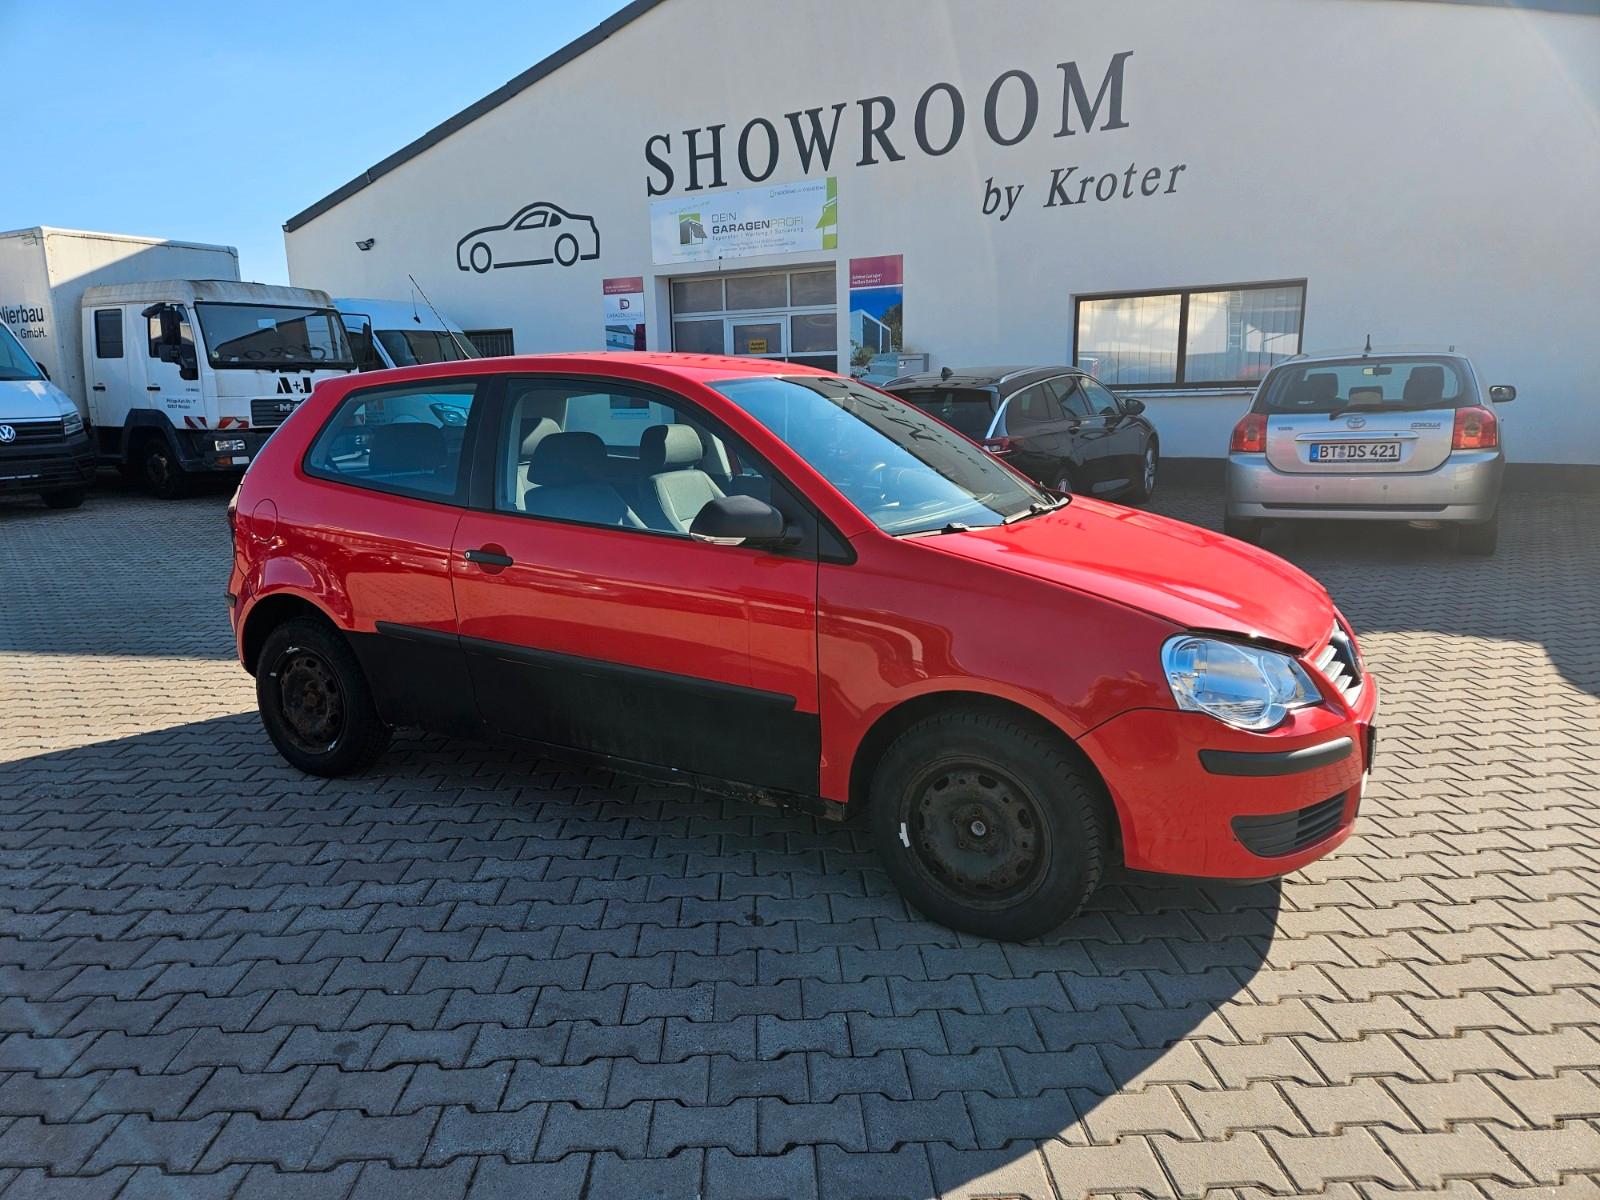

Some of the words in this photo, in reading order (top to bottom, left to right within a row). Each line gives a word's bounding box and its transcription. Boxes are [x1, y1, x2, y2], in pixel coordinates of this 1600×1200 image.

[644, 50, 1134, 198] SHOWROOM
[982, 176, 1025, 221] by
[1043, 162, 1187, 208] Kroter
[711, 212, 737, 224] DEIN
[1319, 445, 1339, 458] BT
[1347, 445, 1366, 458] DS
[1370, 444, 1398, 458] 421
